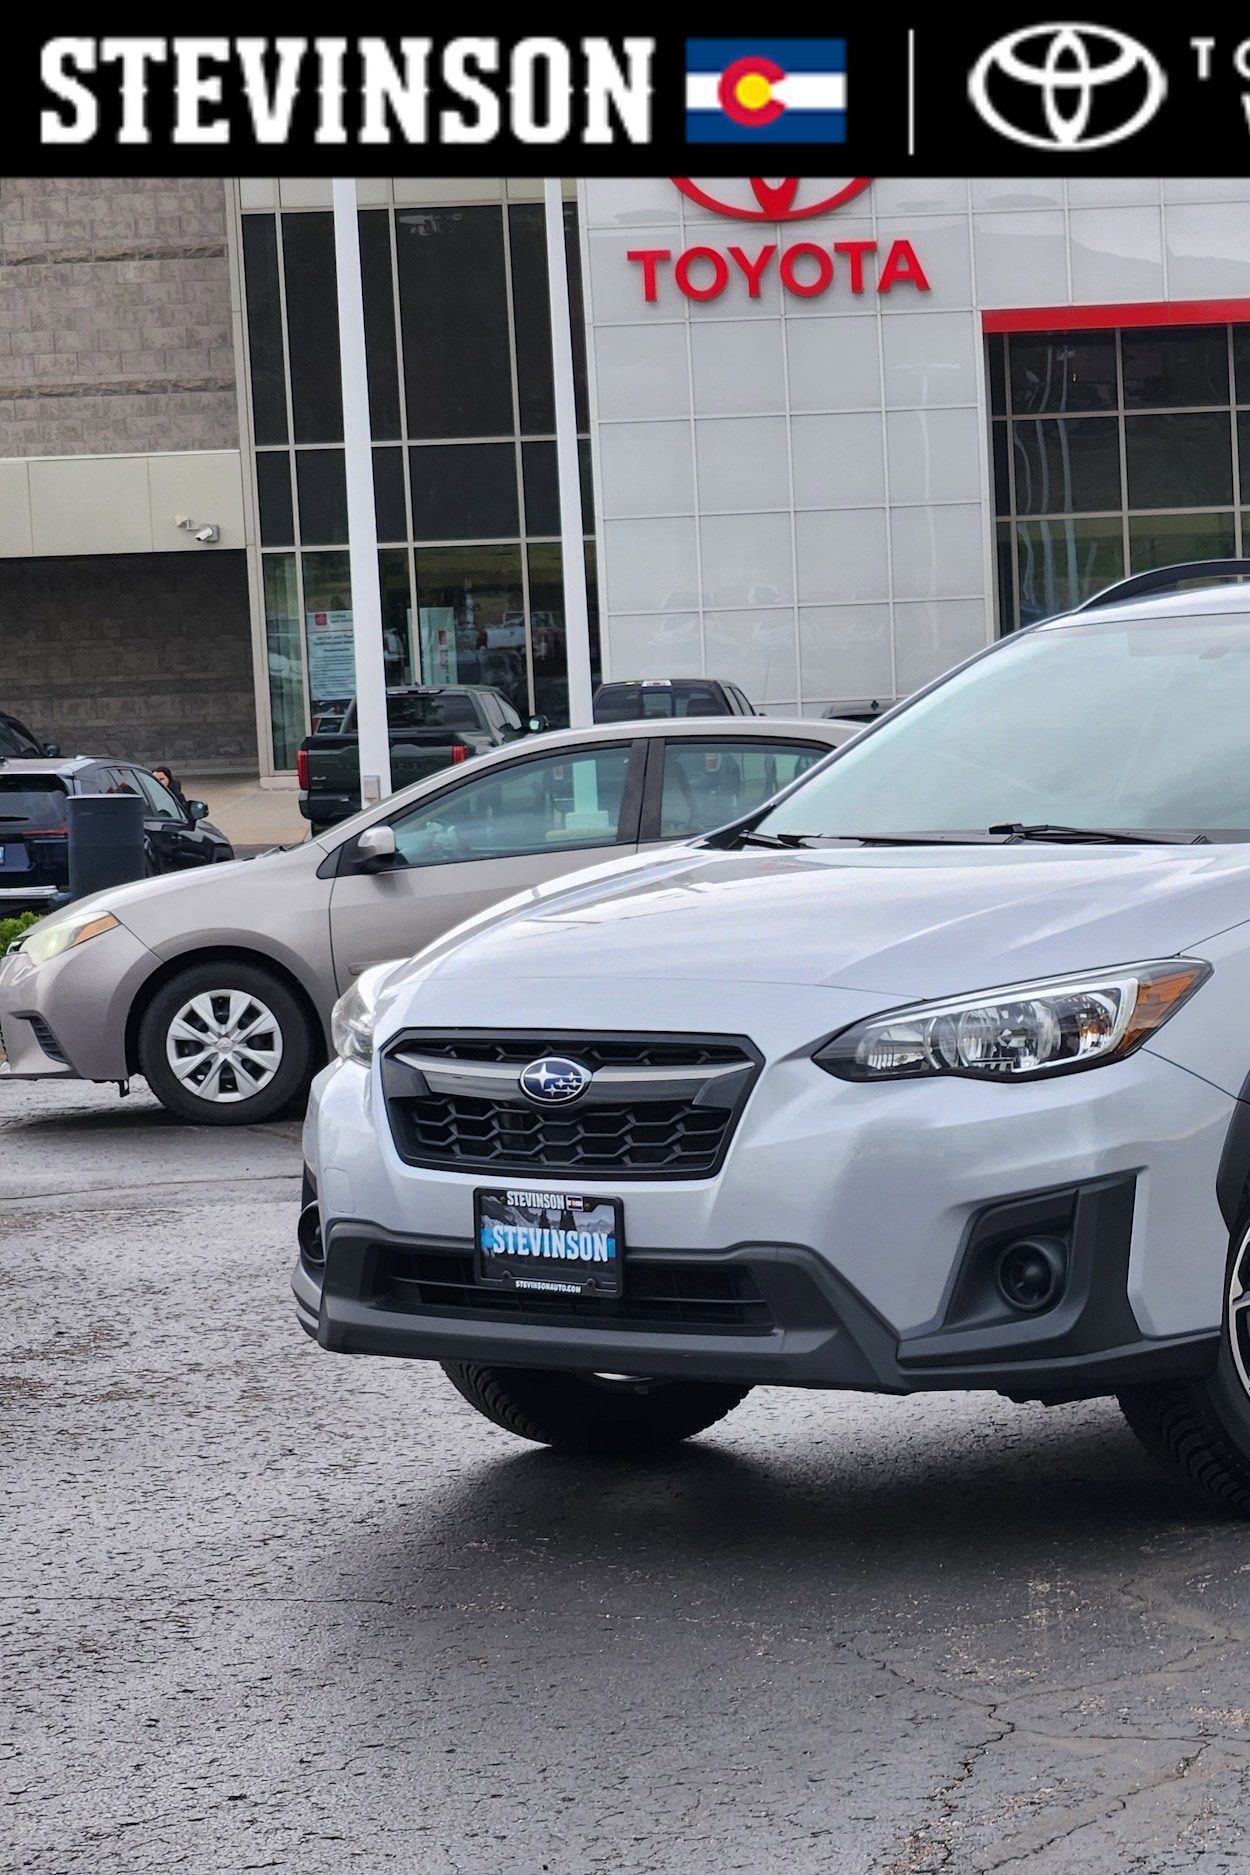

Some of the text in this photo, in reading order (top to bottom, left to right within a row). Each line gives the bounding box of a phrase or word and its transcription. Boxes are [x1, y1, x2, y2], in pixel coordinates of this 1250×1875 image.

[627, 240, 930, 302] TOYOTA
[507, 1191, 565, 1210] STEVINSON
[493, 1225, 608, 1262] STEVINSON
